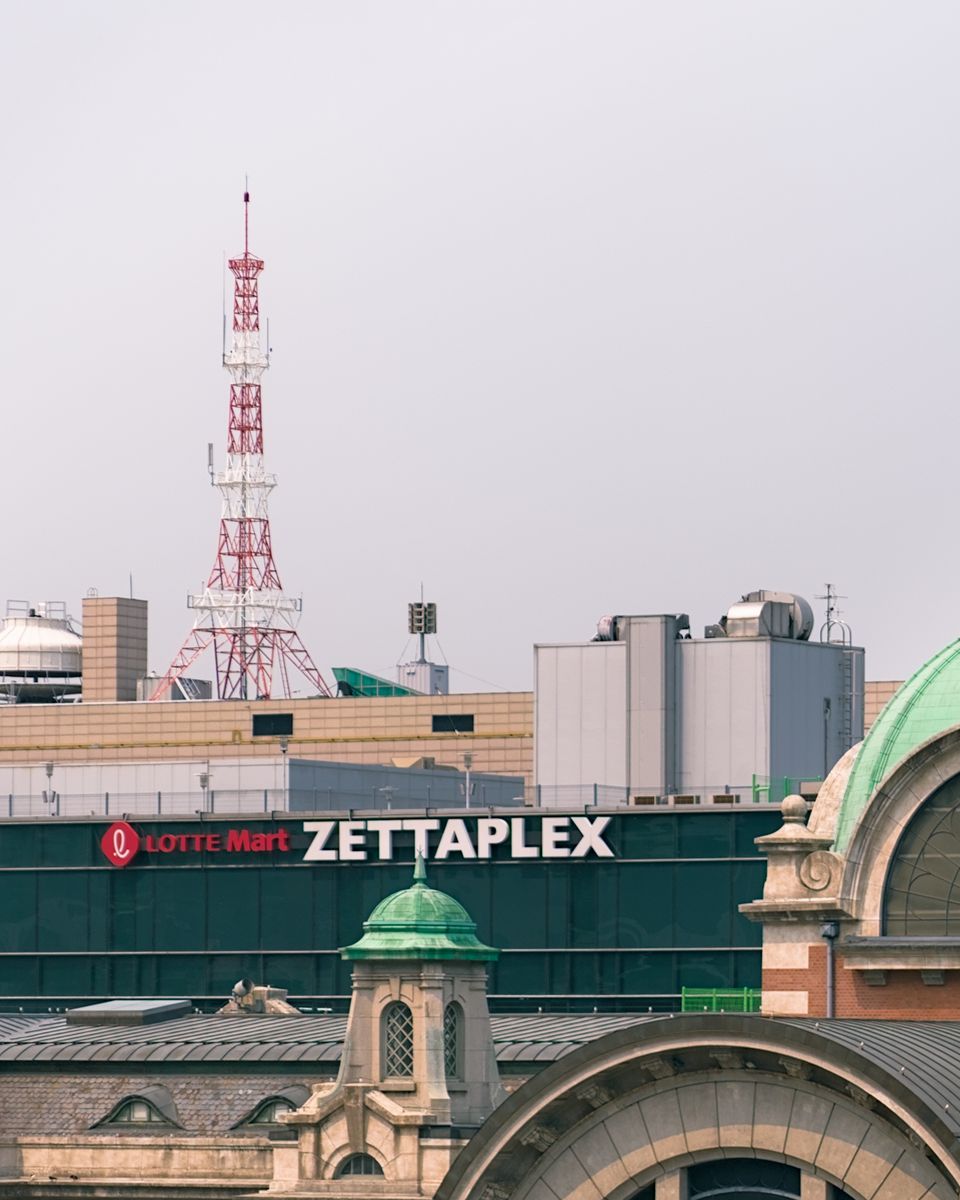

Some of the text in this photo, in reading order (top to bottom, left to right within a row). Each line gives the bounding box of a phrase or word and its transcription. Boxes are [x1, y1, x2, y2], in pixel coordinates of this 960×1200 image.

[146, 827, 290, 853] LOTTE Mart
[302, 816, 616, 862] ZETTAPLEX
